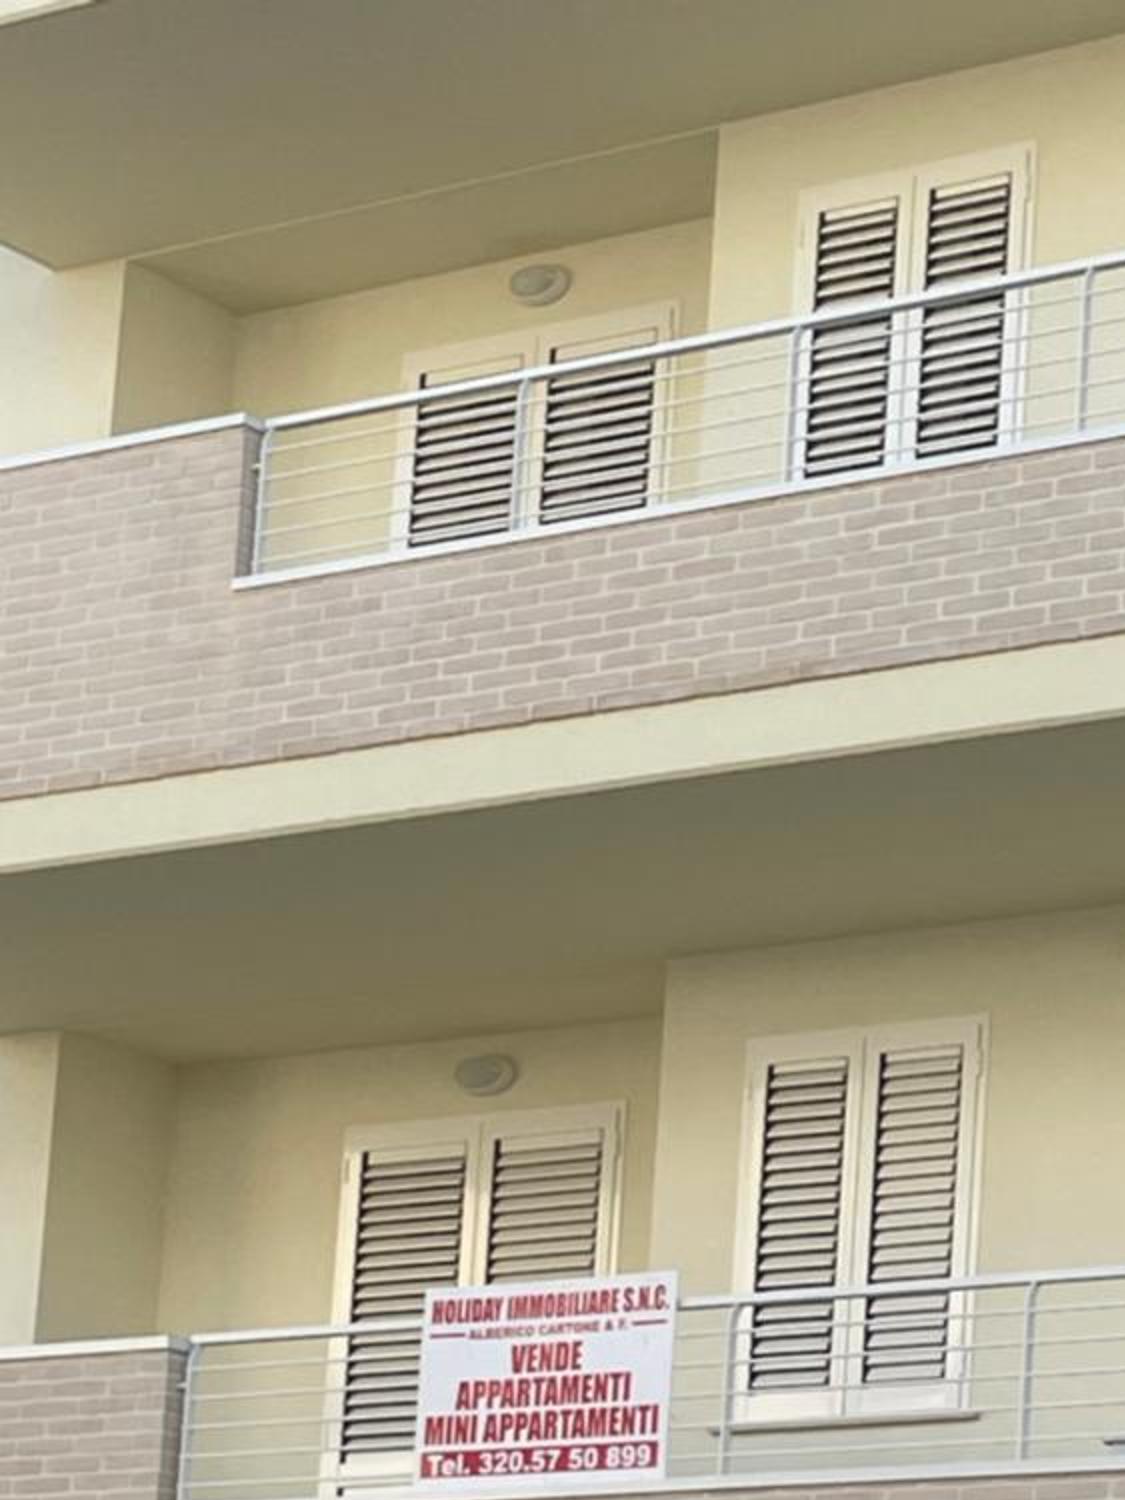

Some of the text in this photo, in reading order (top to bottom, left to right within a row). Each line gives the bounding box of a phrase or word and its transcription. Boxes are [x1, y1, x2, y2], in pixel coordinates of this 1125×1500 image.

[433, 1284, 670, 1325] HOLIDAY IMMOBILIARE S.N.C.
[511, 1341, 583, 1374] VENDE
[455, 1372, 632, 1411] APPARTAMENTI
[424, 1405, 660, 1446] MINI APPARTAMENTI
[427, 1443, 651, 1476] Tel. 320.57 50 899
